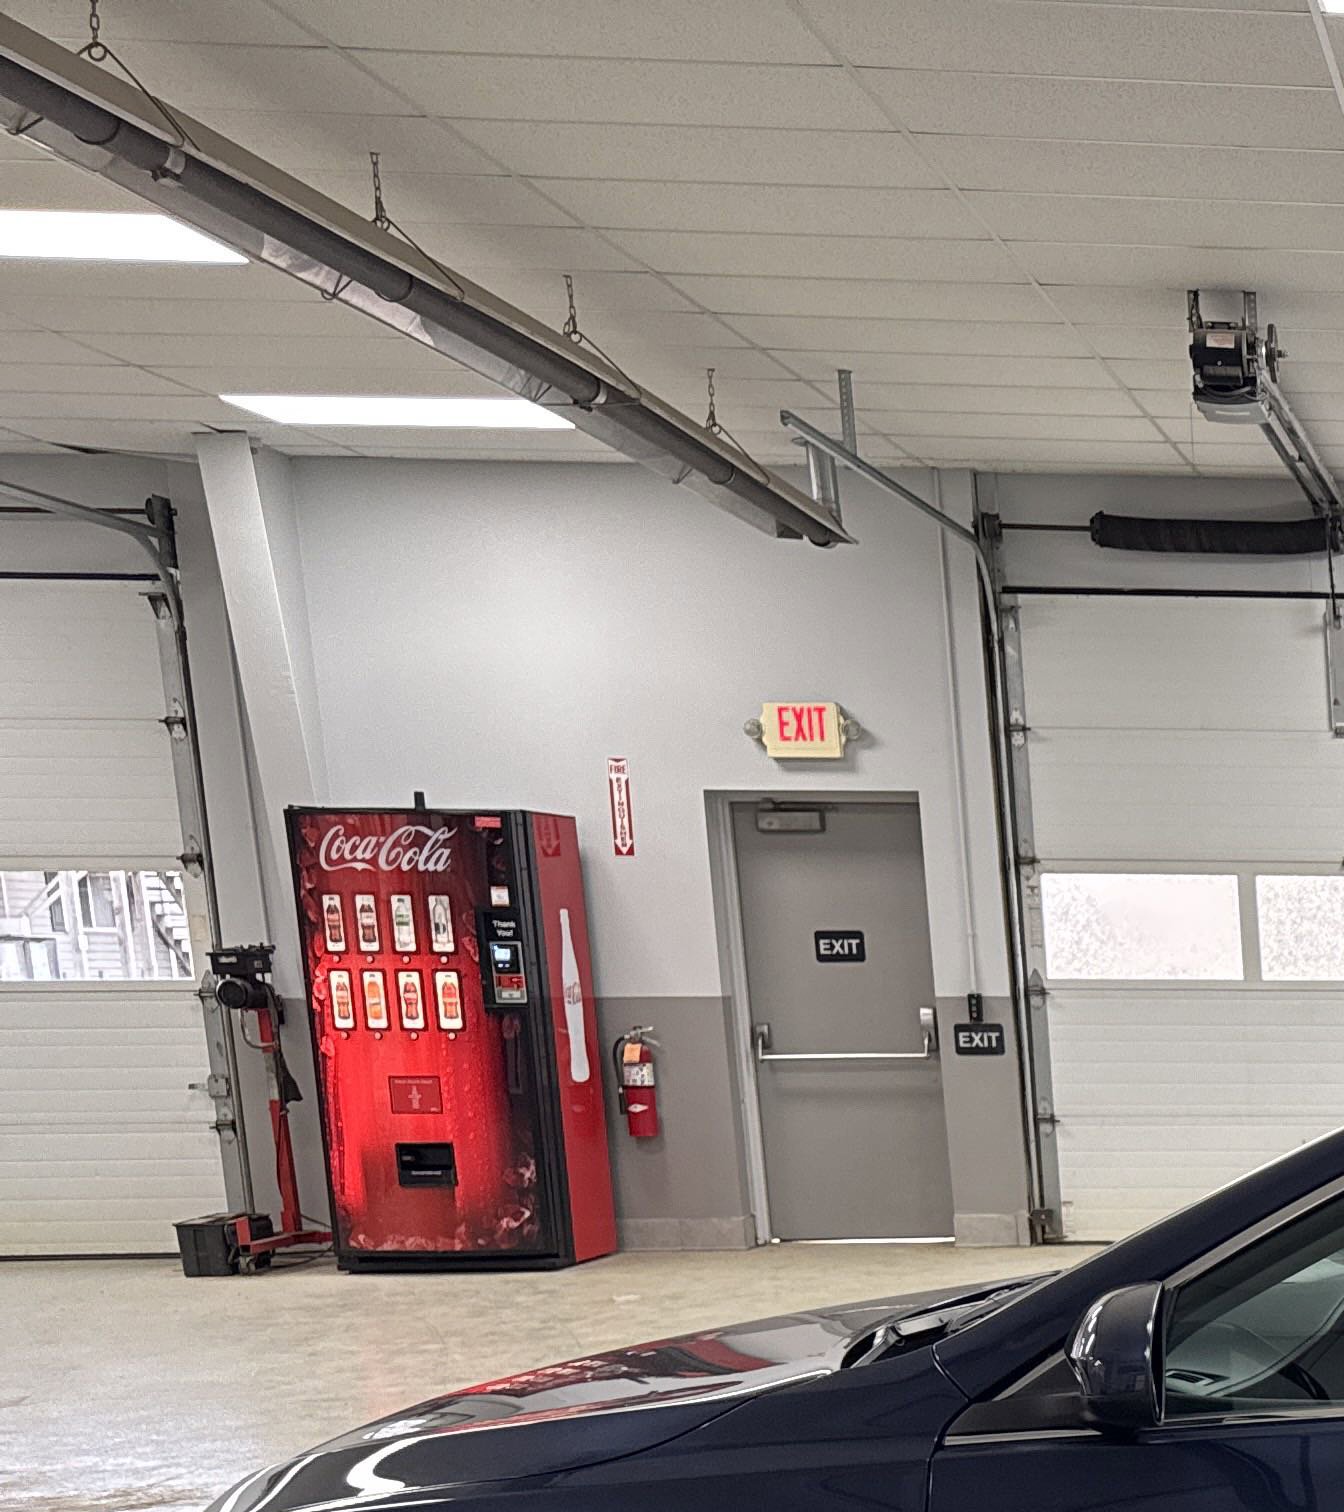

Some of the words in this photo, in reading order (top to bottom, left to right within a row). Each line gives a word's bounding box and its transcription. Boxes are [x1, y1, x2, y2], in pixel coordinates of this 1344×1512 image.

[777, 706, 827, 742] EXIT
[609, 764, 626, 774] FIRE
[319, 824, 457, 872] Coca-Cola
[818, 939, 860, 955] EXIT
[958, 1032, 999, 1048] EXIT
